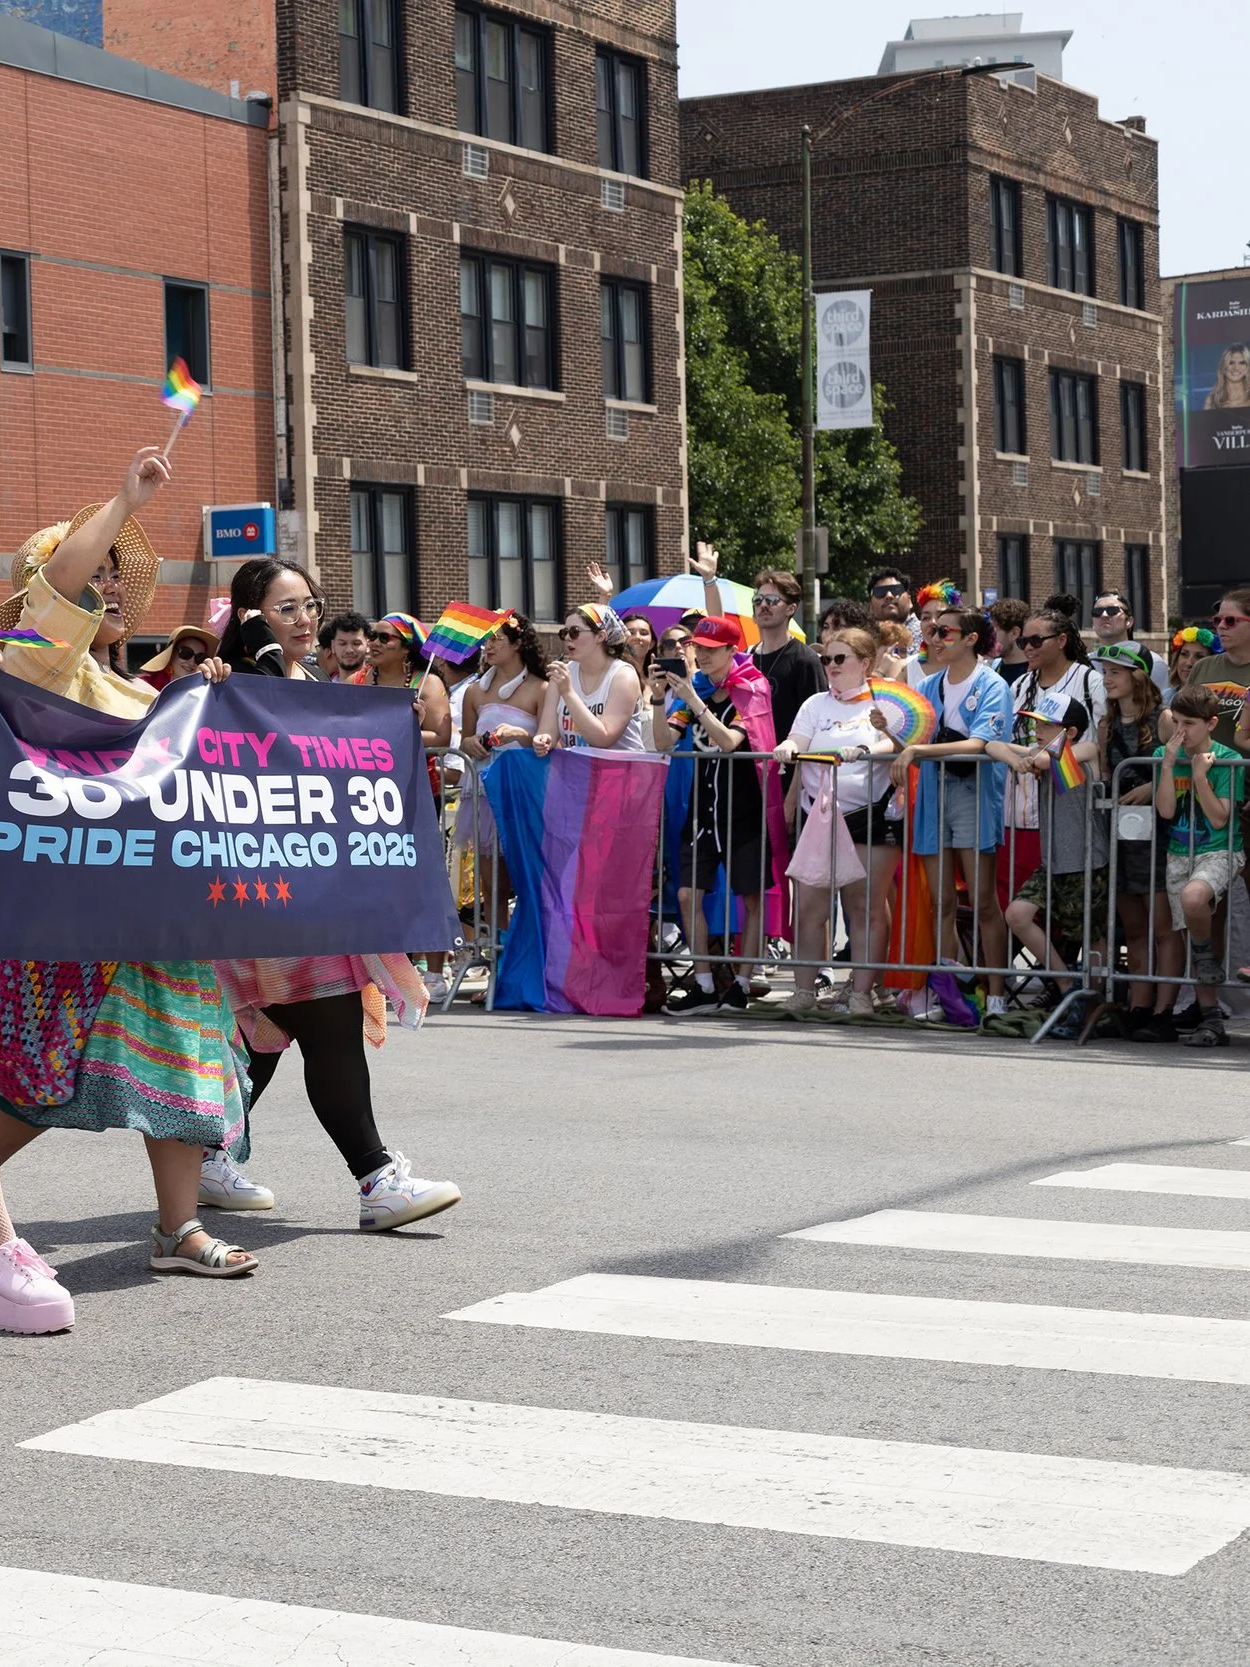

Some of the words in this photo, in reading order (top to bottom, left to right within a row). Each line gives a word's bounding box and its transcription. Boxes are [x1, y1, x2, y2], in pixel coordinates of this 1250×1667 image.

[827, 304, 859, 322] third
[827, 364, 860, 385] third
[825, 384, 863, 401] space
[216, 528, 242, 539] BMO
[196, 727, 278, 768] CITY
[288, 734, 395, 772] TIMES
[8, 760, 123, 819] 30
[134, 769, 338, 825] UNDER
[347, 776, 404, 826] 30
[171, 829, 338, 868] CHICAGO
[348, 831, 417, 867] 2026
